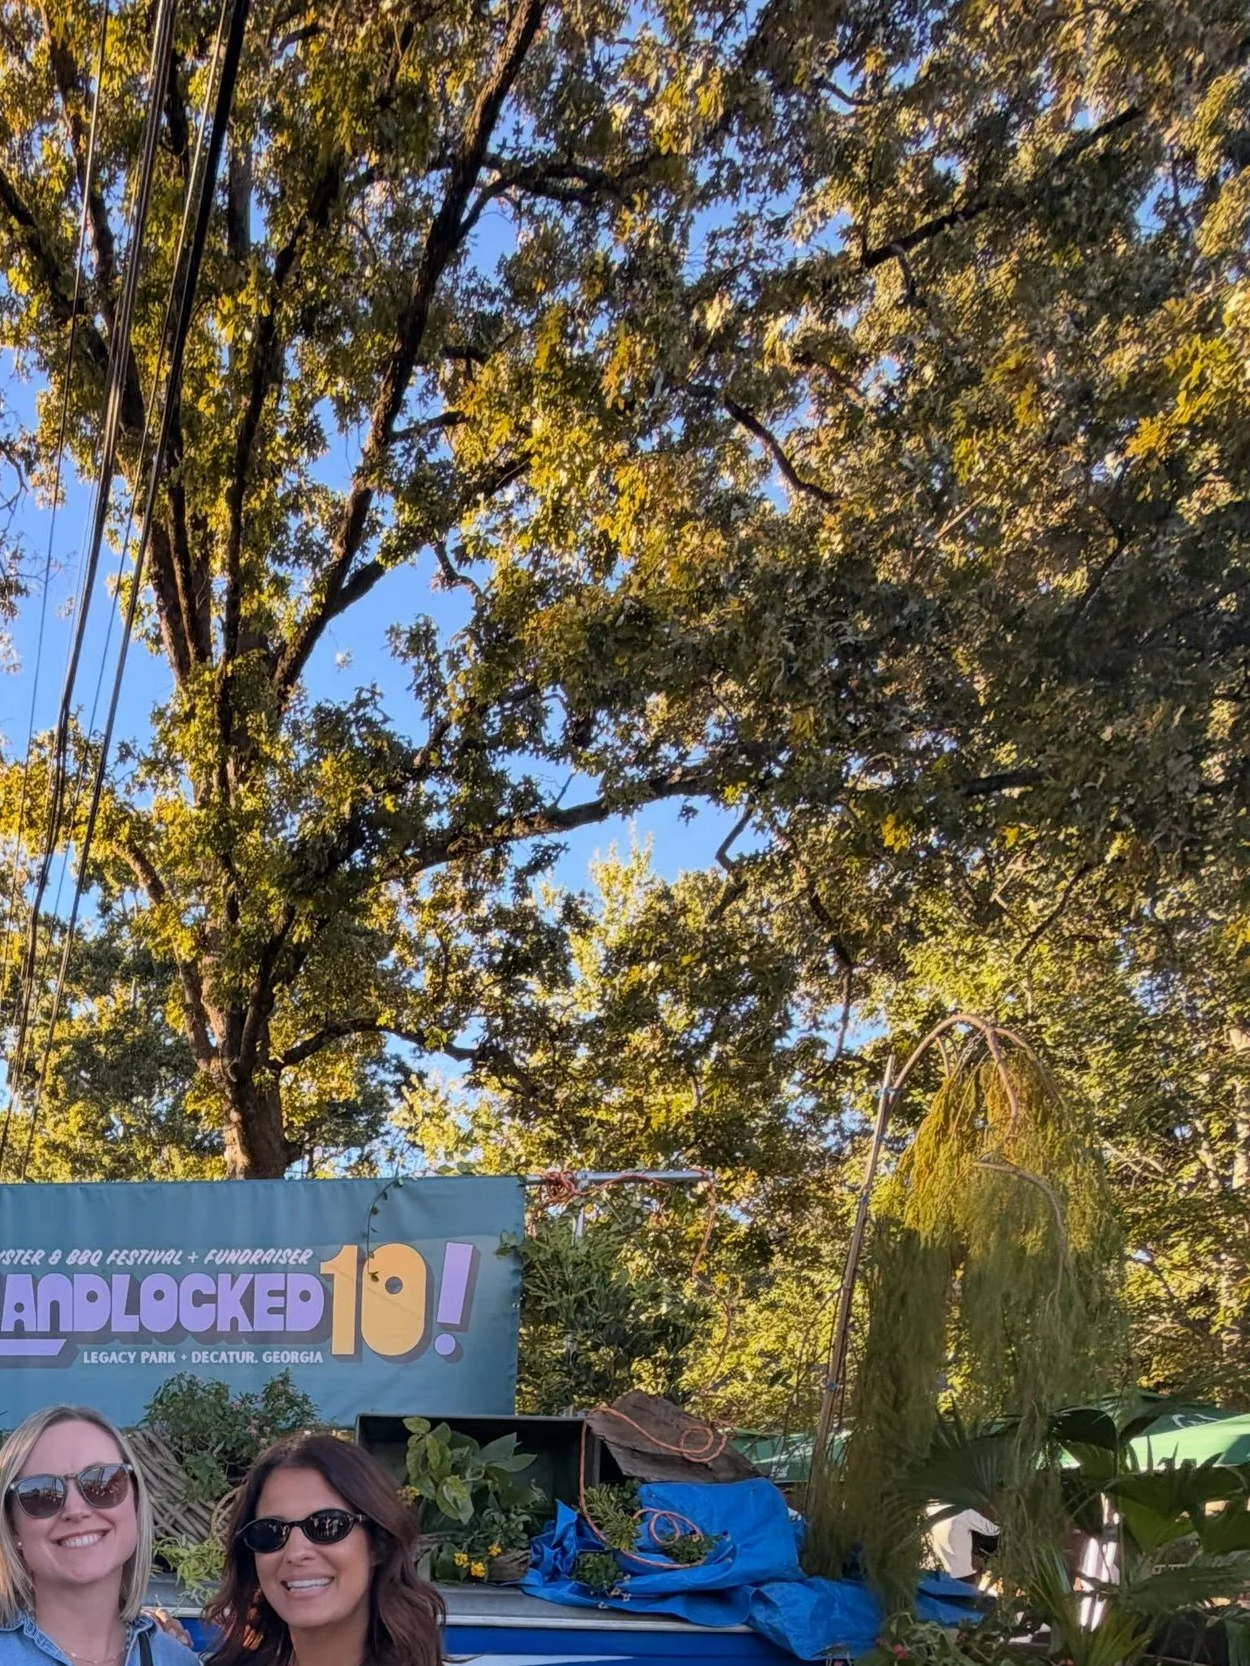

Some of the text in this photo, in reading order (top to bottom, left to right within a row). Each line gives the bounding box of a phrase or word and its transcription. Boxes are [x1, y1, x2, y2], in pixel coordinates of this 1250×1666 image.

[65, 1248, 103, 1267] BBQ
[105, 1248, 183, 1266] FESTIVAL
[203, 1248, 314, 1266] FUNDRAISER
[83, 1351, 137, 1364] LEGACY
[140, 1351, 177, 1364] PARK
[262, 1351, 324, 1364] GEORGIA
